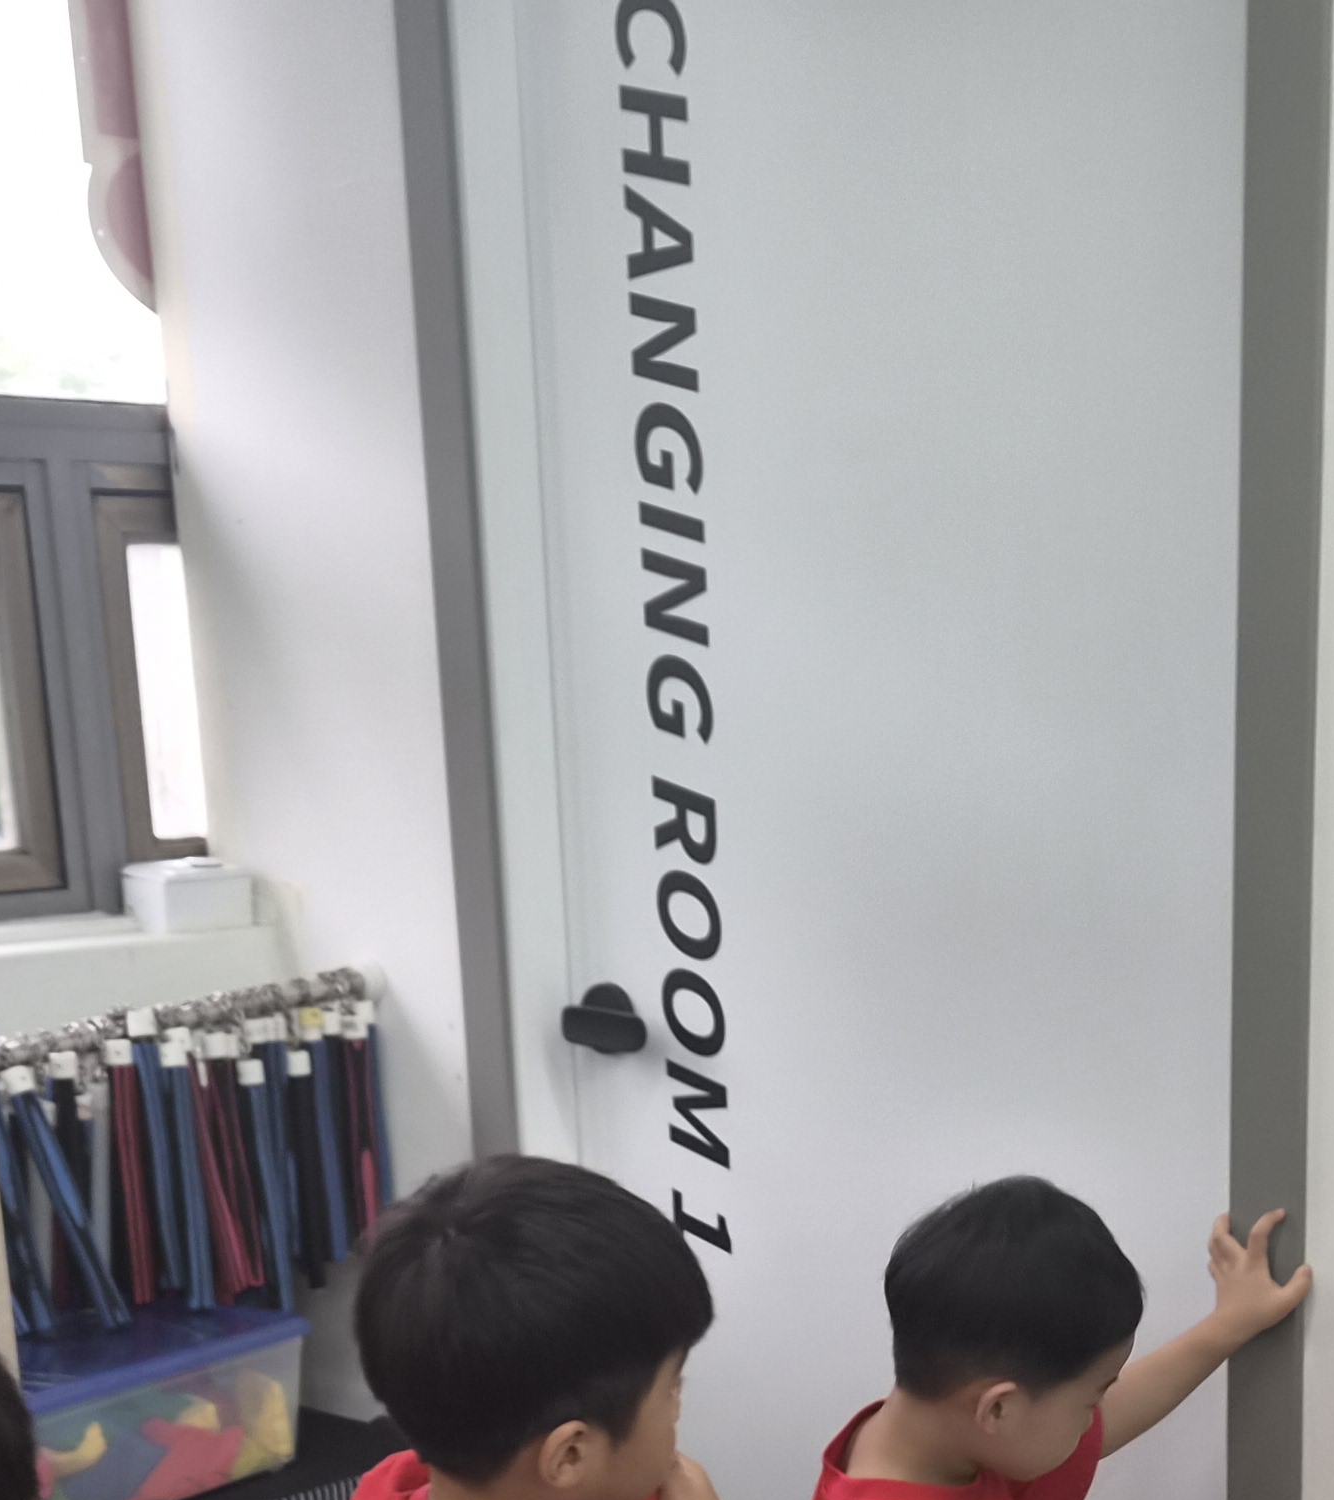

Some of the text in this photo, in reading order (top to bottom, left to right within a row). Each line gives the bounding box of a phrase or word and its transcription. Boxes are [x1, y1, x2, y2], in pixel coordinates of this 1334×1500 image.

[614, 0, 733, 1255] CHANGING ROOM 1
